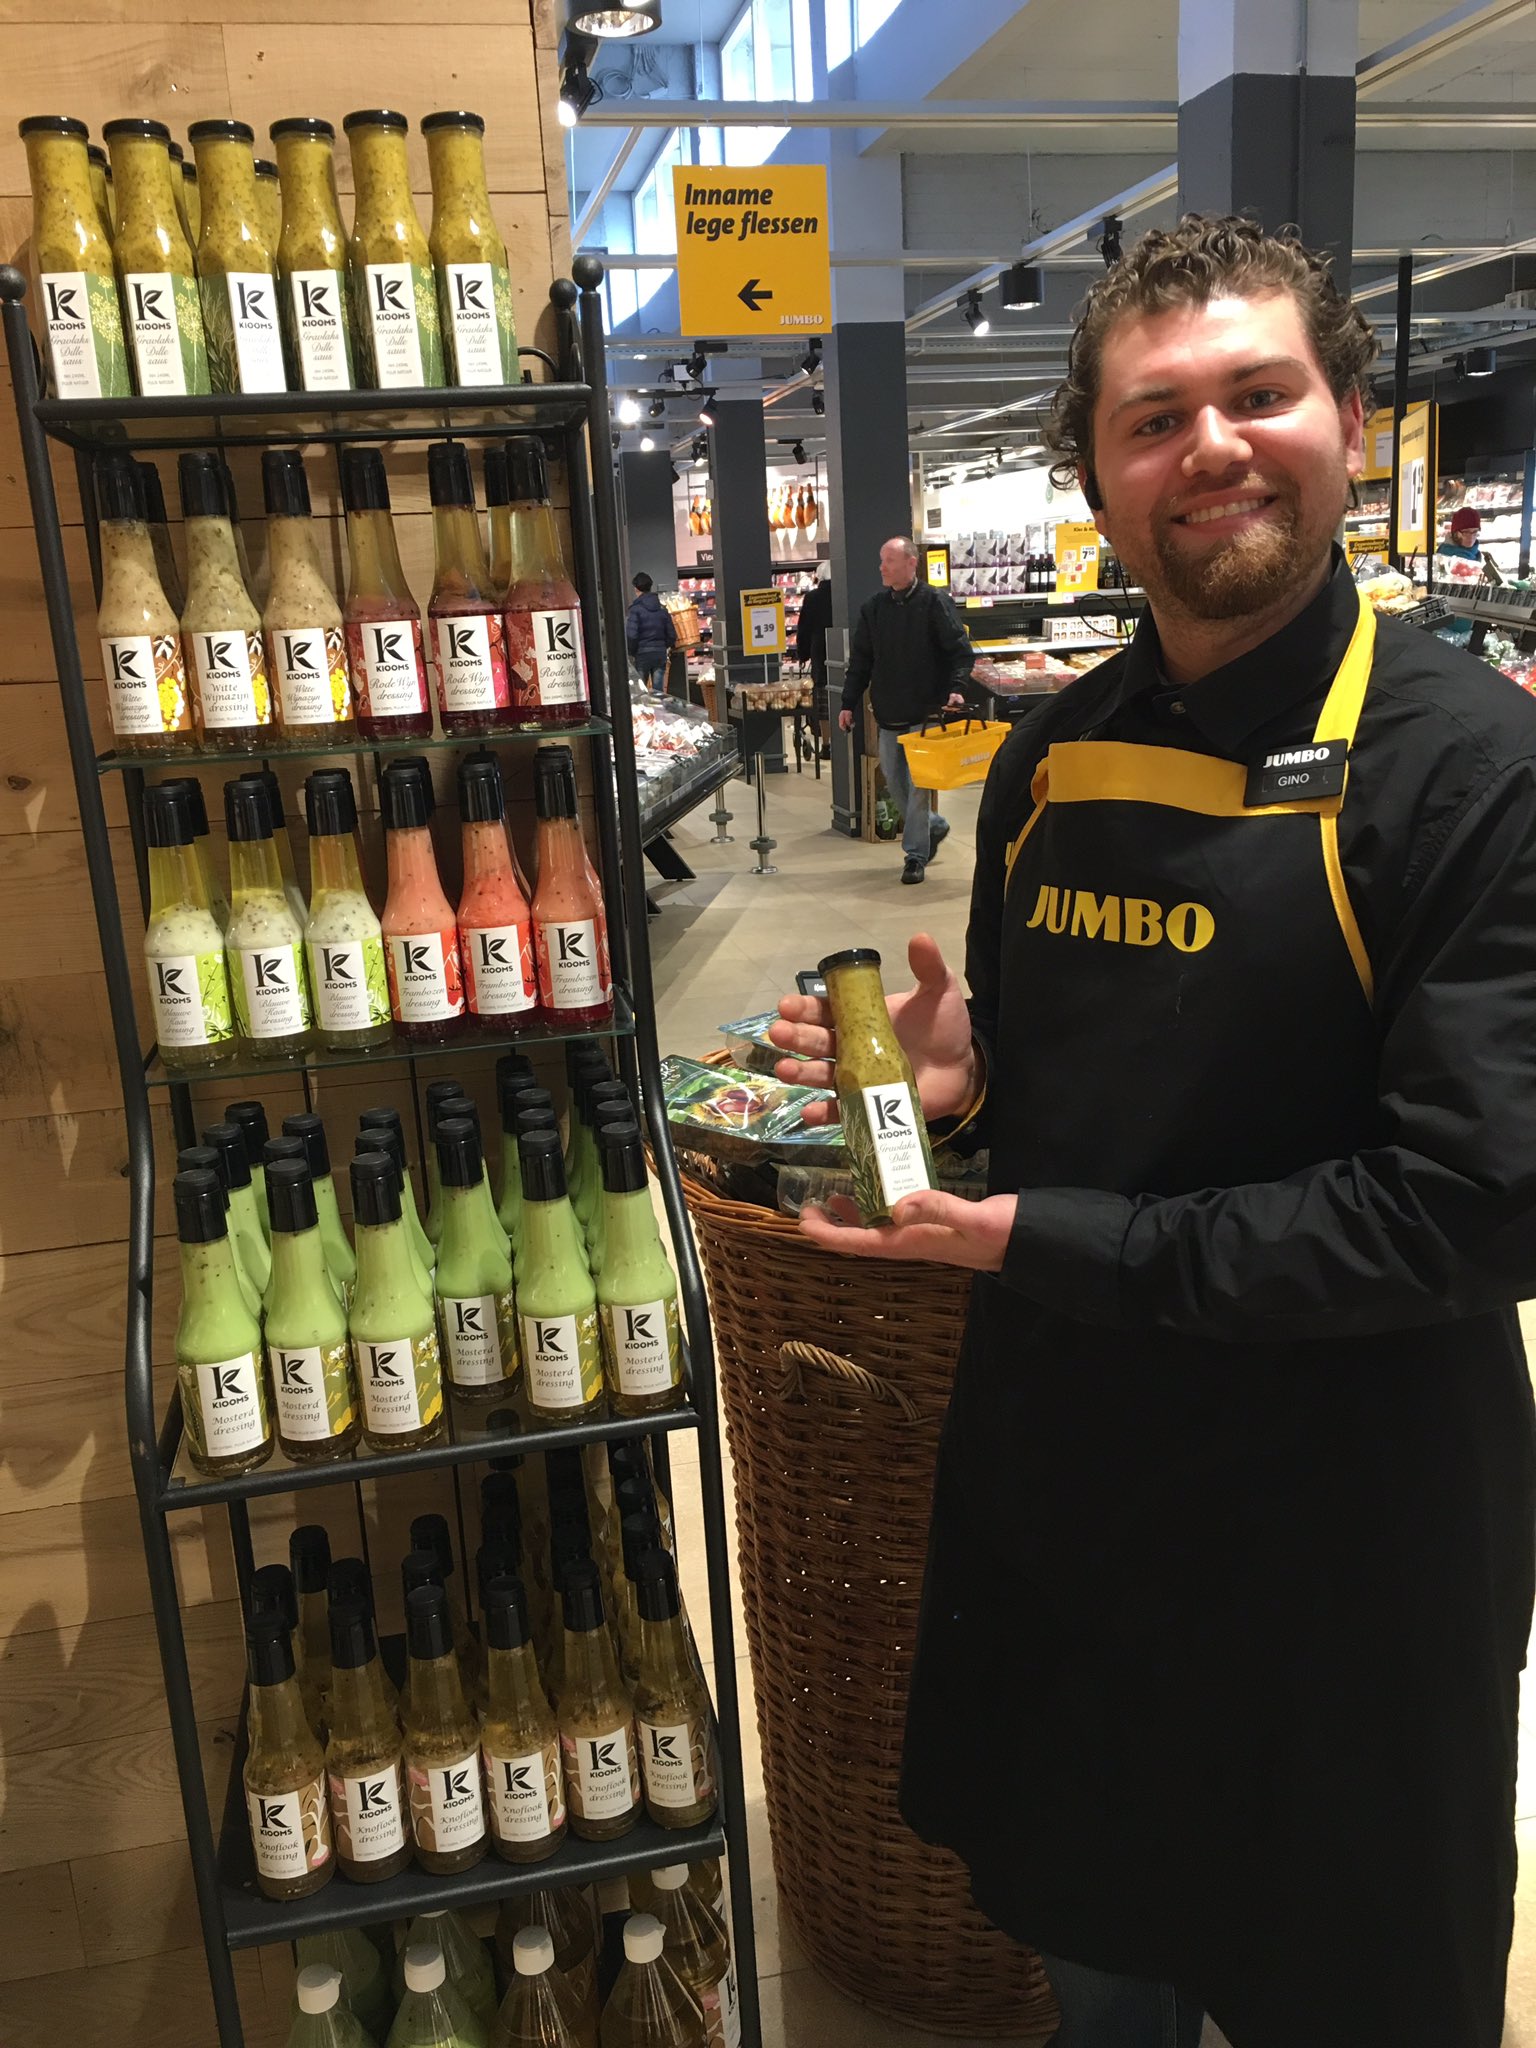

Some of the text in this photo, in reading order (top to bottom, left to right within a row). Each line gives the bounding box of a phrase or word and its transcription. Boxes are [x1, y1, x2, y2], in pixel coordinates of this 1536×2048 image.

[684, 183, 773, 205] Inname
[686, 210, 818, 241] lege flessen
[376, 312, 410, 321] KIOOMS
[456, 311, 491, 321] KIOOMS
[779, 315, 824, 325] JUMBO
[50, 322, 86, 331] KIOOMS
[136, 322, 171, 331] KIOOMS
[239, 321, 272, 330] KIOOMS
[302, 318, 337, 327] KIOOMS
[546, 652, 578, 661] KIOOMS
[376, 664, 409, 672] KIOOMS
[449, 659, 482, 668] KIOOMS
[206, 671, 241, 679] KIOOMS
[286, 672, 320, 680] KIOOMS
[114, 681, 147, 690] KIOOMS
[211, 683, 238, 692] Witte
[208, 701, 249, 713] dressing
[1262, 747, 1330, 769] JUMBO
[1278, 772, 1310, 787] GINO
[1026, 884, 1216, 953] JUMBO
[481, 965, 514, 974] KIOOMS
[558, 960, 591, 969] KIOOMS
[404, 973, 437, 982] KIOOMS
[324, 981, 358, 989] KIOOMS
[256, 987, 290, 996] KIOOMS
[159, 996, 191, 1004] KIOOMS
[878, 1129, 912, 1140] KIOOMS
[455, 1332, 489, 1342] KIOOMS
[625, 1339, 659, 1350] KIOOMS
[456, 1345, 495, 1357] Mosterd
[456, 1356, 495, 1368] dressing
[535, 1353, 569, 1362] KIOOMS
[624, 1351, 664, 1366] Mosterd
[535, 1366, 576, 1378] Mosterd
[625, 1363, 665, 1376] dressing
[370, 1378, 405, 1388] KIOOMS
[536, 1378, 575, 1390] dressing
[281, 1386, 314, 1395] KIOOMS
[212, 1394, 250, 1409] KIOOMS
[370, 1391, 411, 1404] Mosterd
[281, 1399, 320, 1411] Mosterd
[371, 1403, 411, 1415] dressing
[211, 1407, 255, 1426] Mosterd
[282, 1410, 321, 1422] dressing
[213, 1419, 256, 1436] dressing
[651, 1759, 683, 1767] KIOOMS
[589, 1766, 622, 1778] KIOOMS
[504, 1790, 538, 1800] KIOOMS
[443, 1792, 475, 1810] KIOOMS
[358, 1804, 393, 1820] KIOOMS
[260, 1828, 293, 1837] KIOOMS
